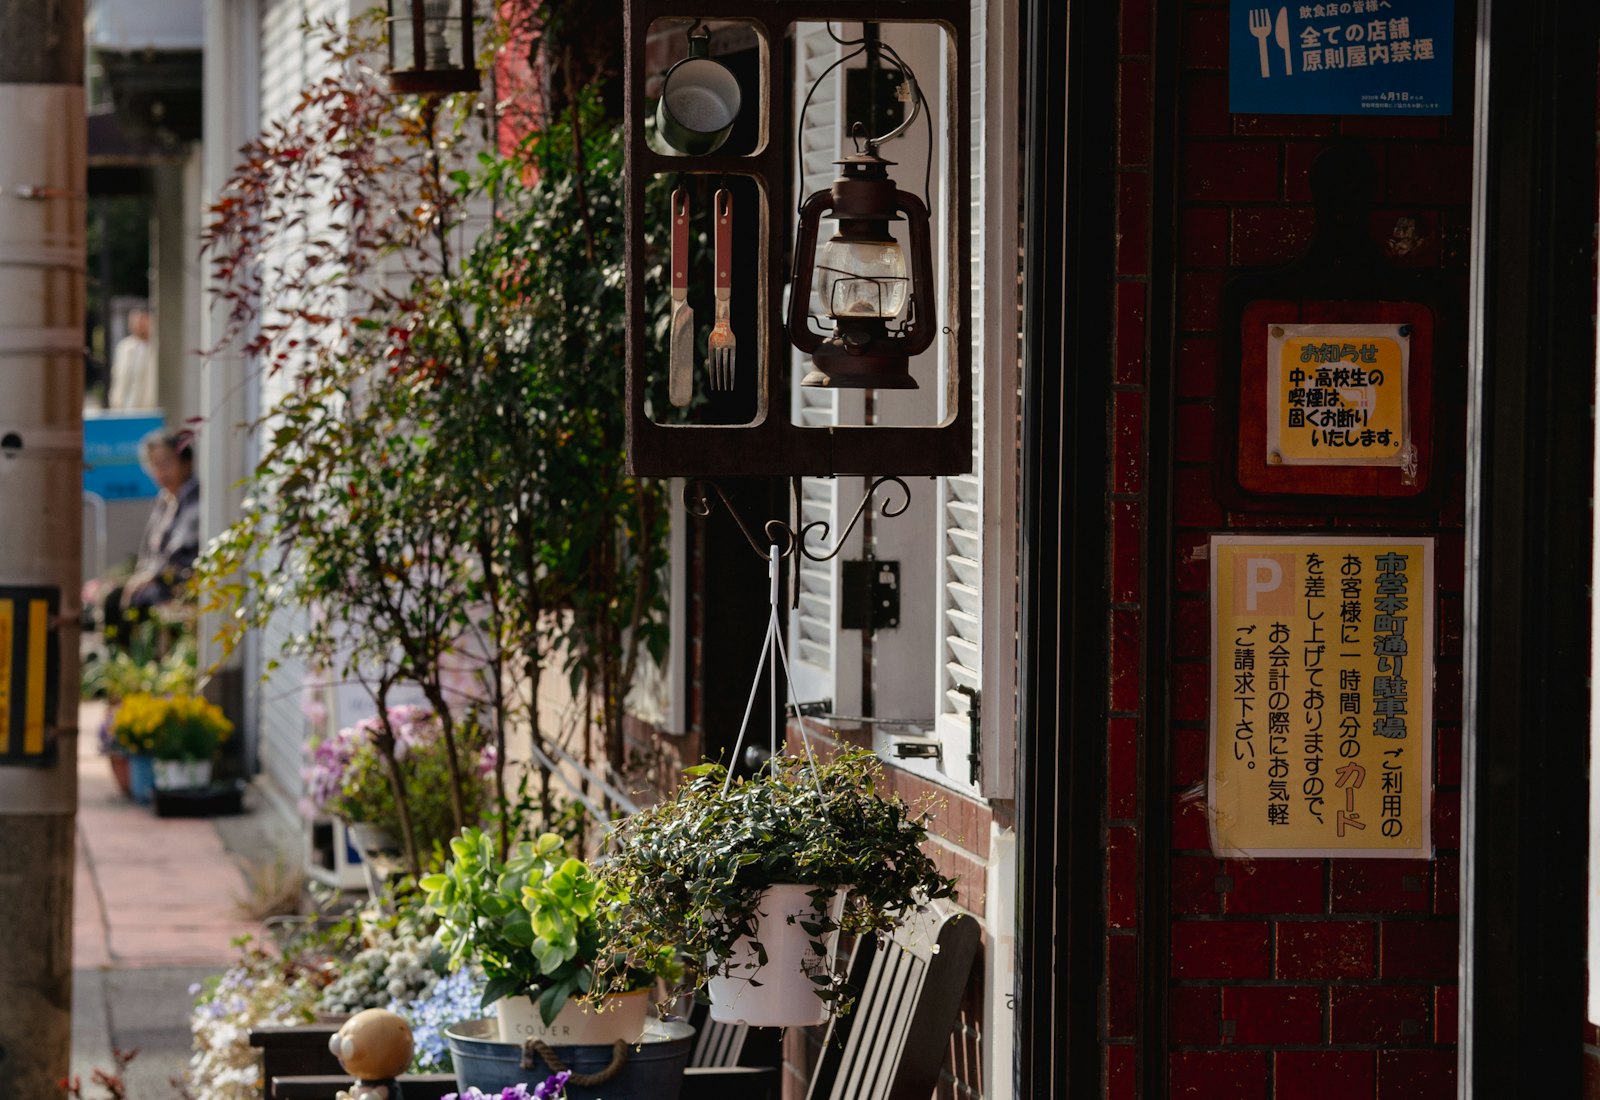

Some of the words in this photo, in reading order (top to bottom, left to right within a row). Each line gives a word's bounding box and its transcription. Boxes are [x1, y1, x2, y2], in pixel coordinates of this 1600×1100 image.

[1299, 0, 1392, 19] 飲食店の皆様へ
[1300, 17, 1410, 48] 全ての店舗
[1302, 38, 1435, 72] 原則屋内禁煙
[1300, 343, 1378, 363] お知らせ
[1289, 367, 1384, 387] 中・高校生の
[1288, 389, 1346, 408] 喫煙は、
[1288, 408, 1368, 428] 固くお断り
[1311, 429, 1400, 447] いたします。
[1233, 624, 1257, 770] ご請求下さい。
[1303, 552, 1325, 826] を差し上げておりますので、
[1268, 621, 1291, 826] お会計の際にお気軽
[1381, 748, 1403, 838] ご利用の
